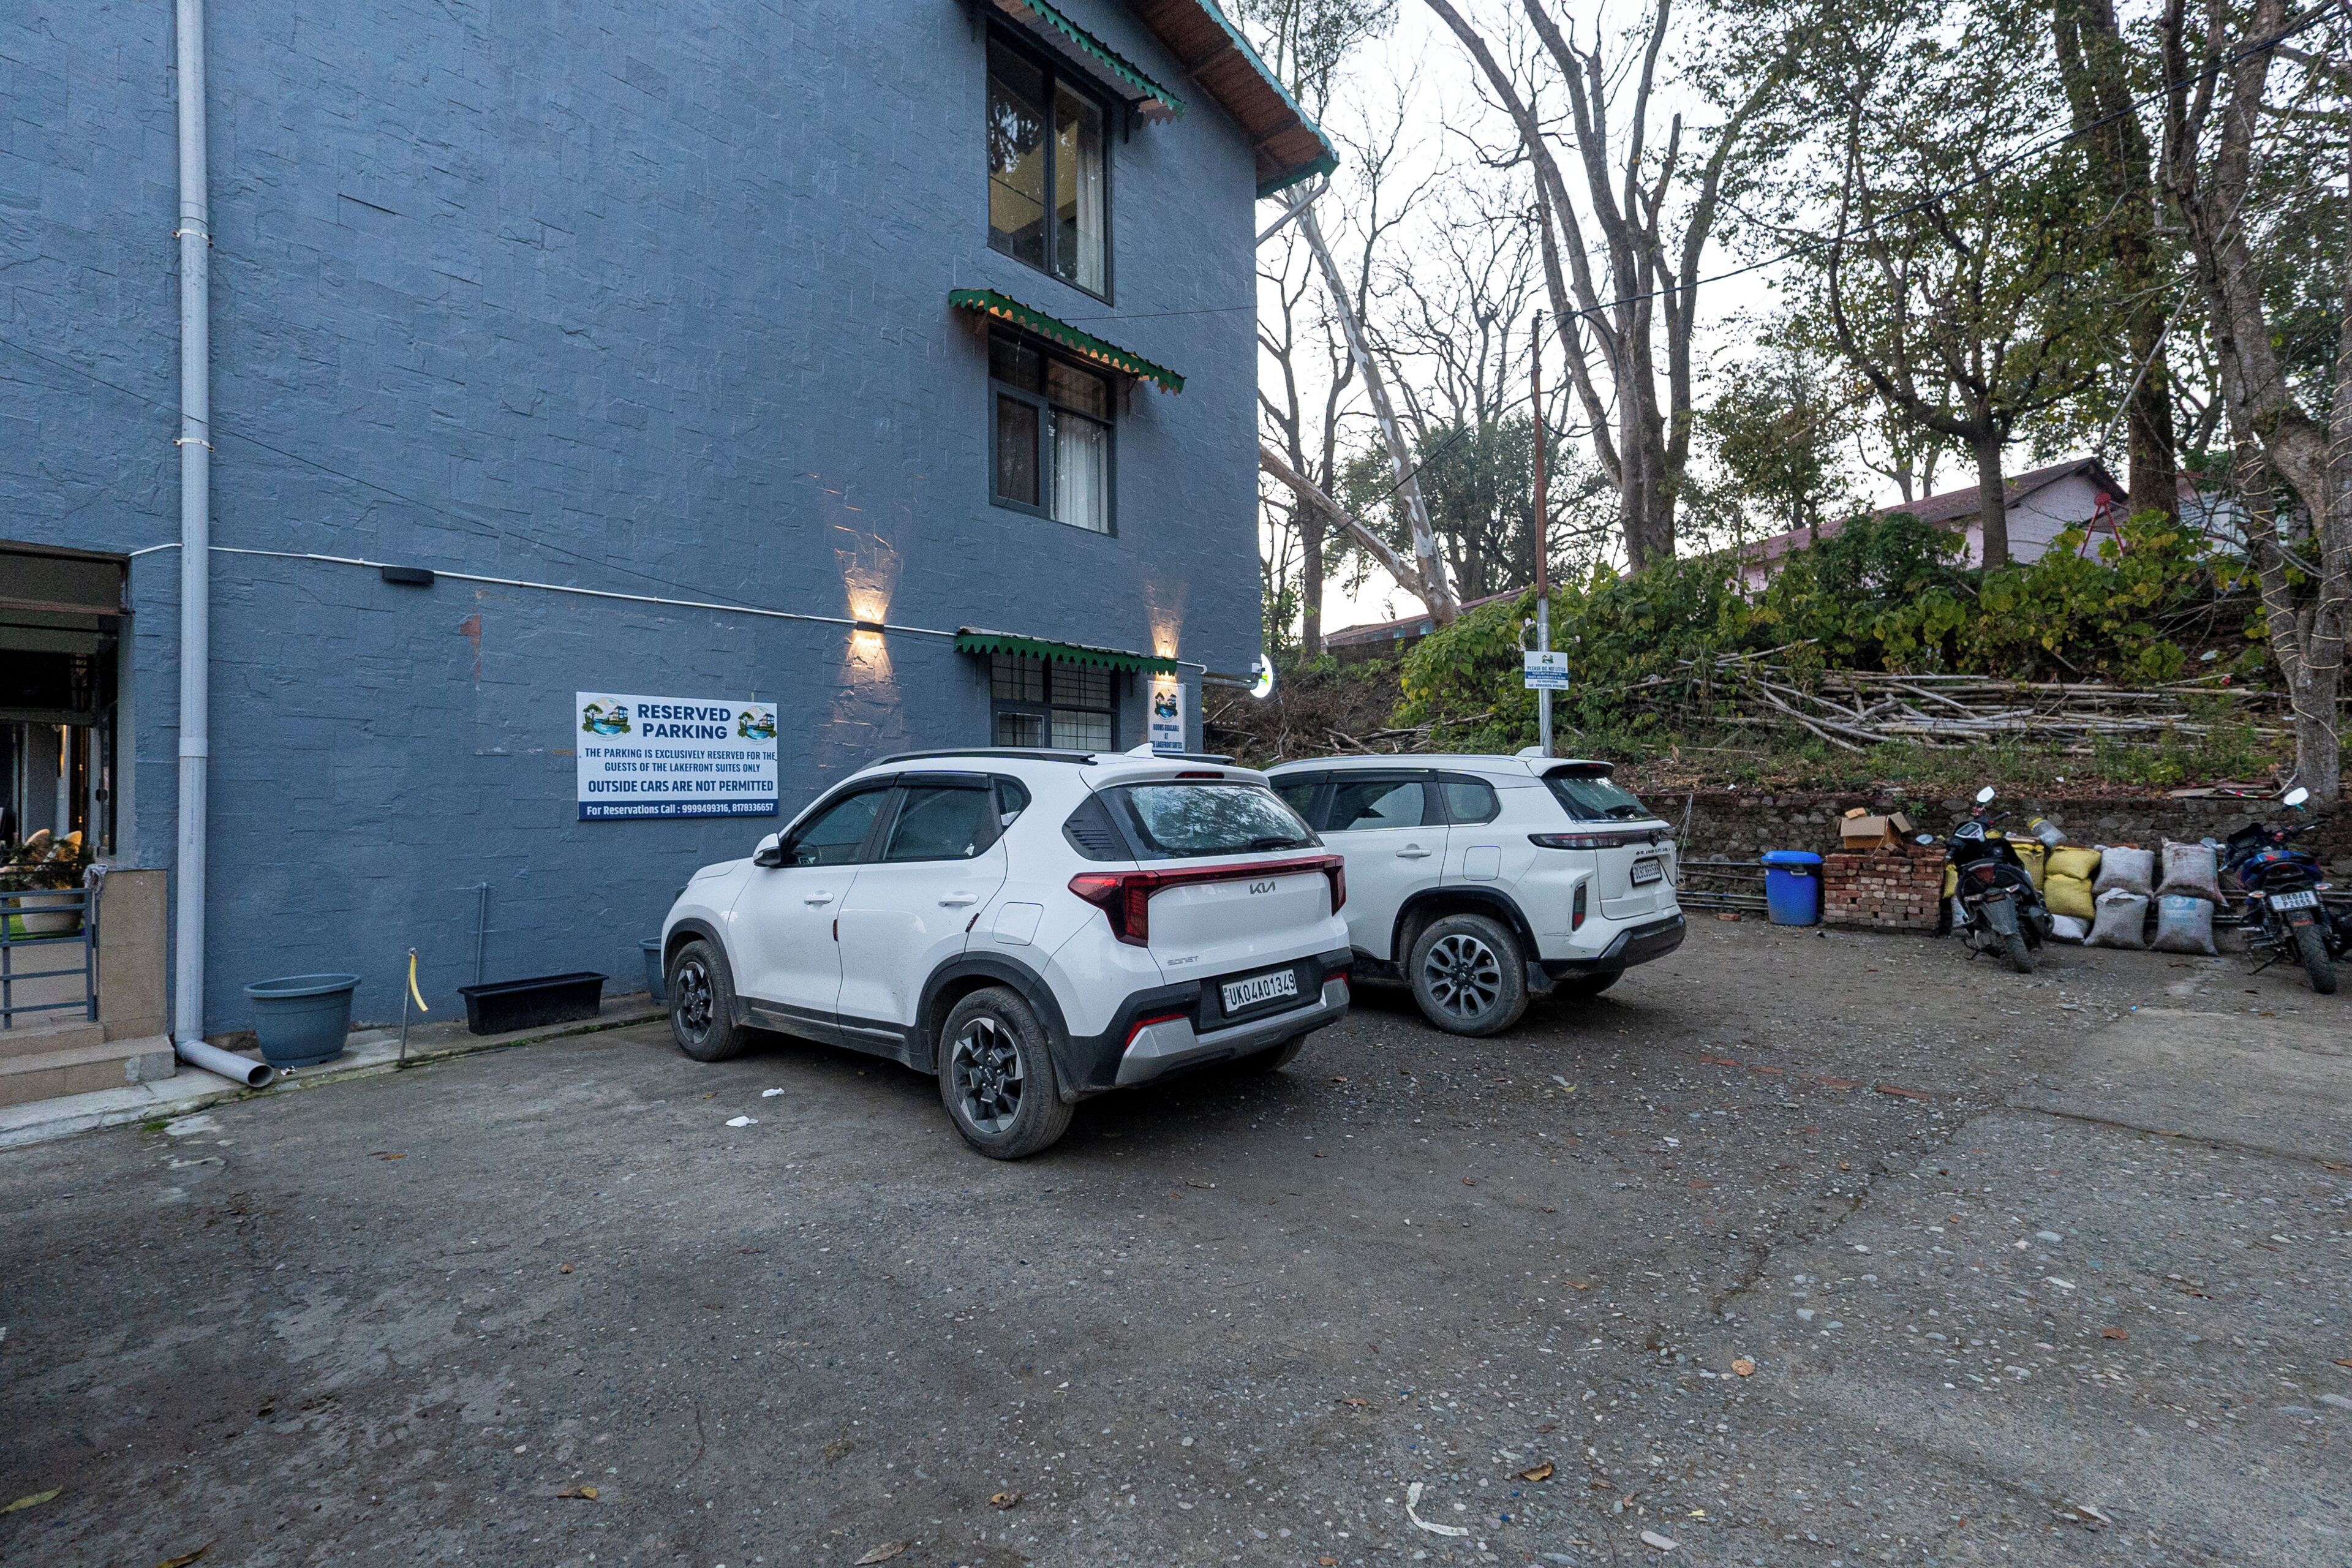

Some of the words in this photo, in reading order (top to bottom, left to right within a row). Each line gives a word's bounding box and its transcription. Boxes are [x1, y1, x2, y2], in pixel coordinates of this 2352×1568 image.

[638, 704, 731, 722] RESERVED
[643, 723, 728, 739] PARKING
[584, 748, 601, 757] THE
[604, 748, 642, 758] PARKING
[645, 749, 653, 758] IS
[655, 750, 705, 759] EXCLUSIVELY
[707, 750, 744, 760] RESERVED
[747, 751, 761, 760] FOR
[762, 752, 775, 761] THE
[605, 762, 637, 772] GUESTS
[639, 763, 650, 772] OF
[652, 763, 667, 772] THE
[669, 763, 713, 772] LAKEFRONT
[715, 764, 741, 772] SUITES
[743, 764, 760, 772] ONLY
[588, 780, 638, 793] OUTSIDE
[641, 780, 669, 792] CARS
[672, 780, 693, 792] ARE
[696, 780, 717, 792] NOT
[719, 780, 774, 791] PERMITTED
[587, 806, 601, 815] For
[603, 804, 658, 815] Reservations
[661, 804, 676, 813] Call
[732, 803, 774, 812] 8178336657
[1250, 881, 1276, 895] KIA
[2280, 892, 2310, 902] UK04A
[2283, 899, 2312, 908] P2655
[1167, 956, 1199, 966] SONET
[1229, 973, 1295, 1006] UK04AQ1349
